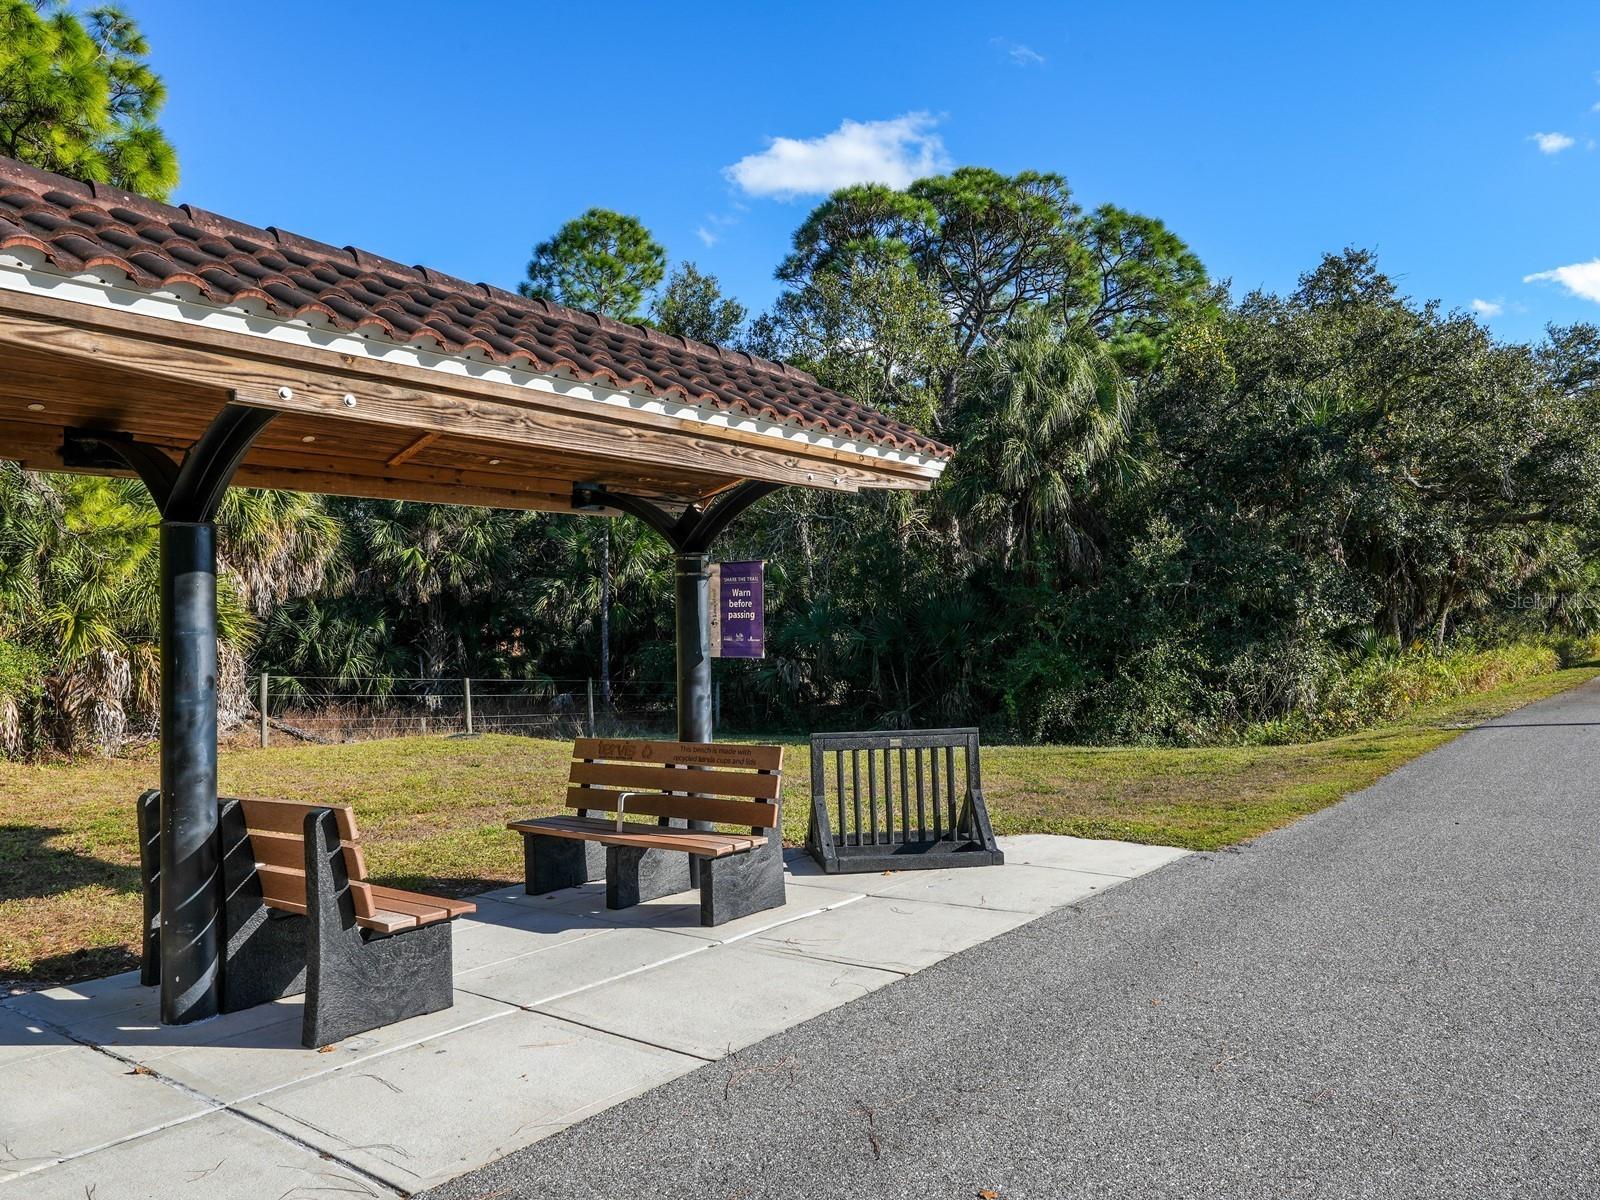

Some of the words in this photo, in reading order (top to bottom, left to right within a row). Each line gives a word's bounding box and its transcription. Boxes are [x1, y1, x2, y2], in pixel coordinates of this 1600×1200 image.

[731, 588, 751, 597] Warn
[728, 599, 753, 608] before
[727, 610, 756, 621] passing
[680, 745, 692, 753] This
[693, 746, 711, 754] bench
[737, 748, 752, 756] with
[672, 754, 698, 763] recycled
[716, 758, 732, 766] cups
